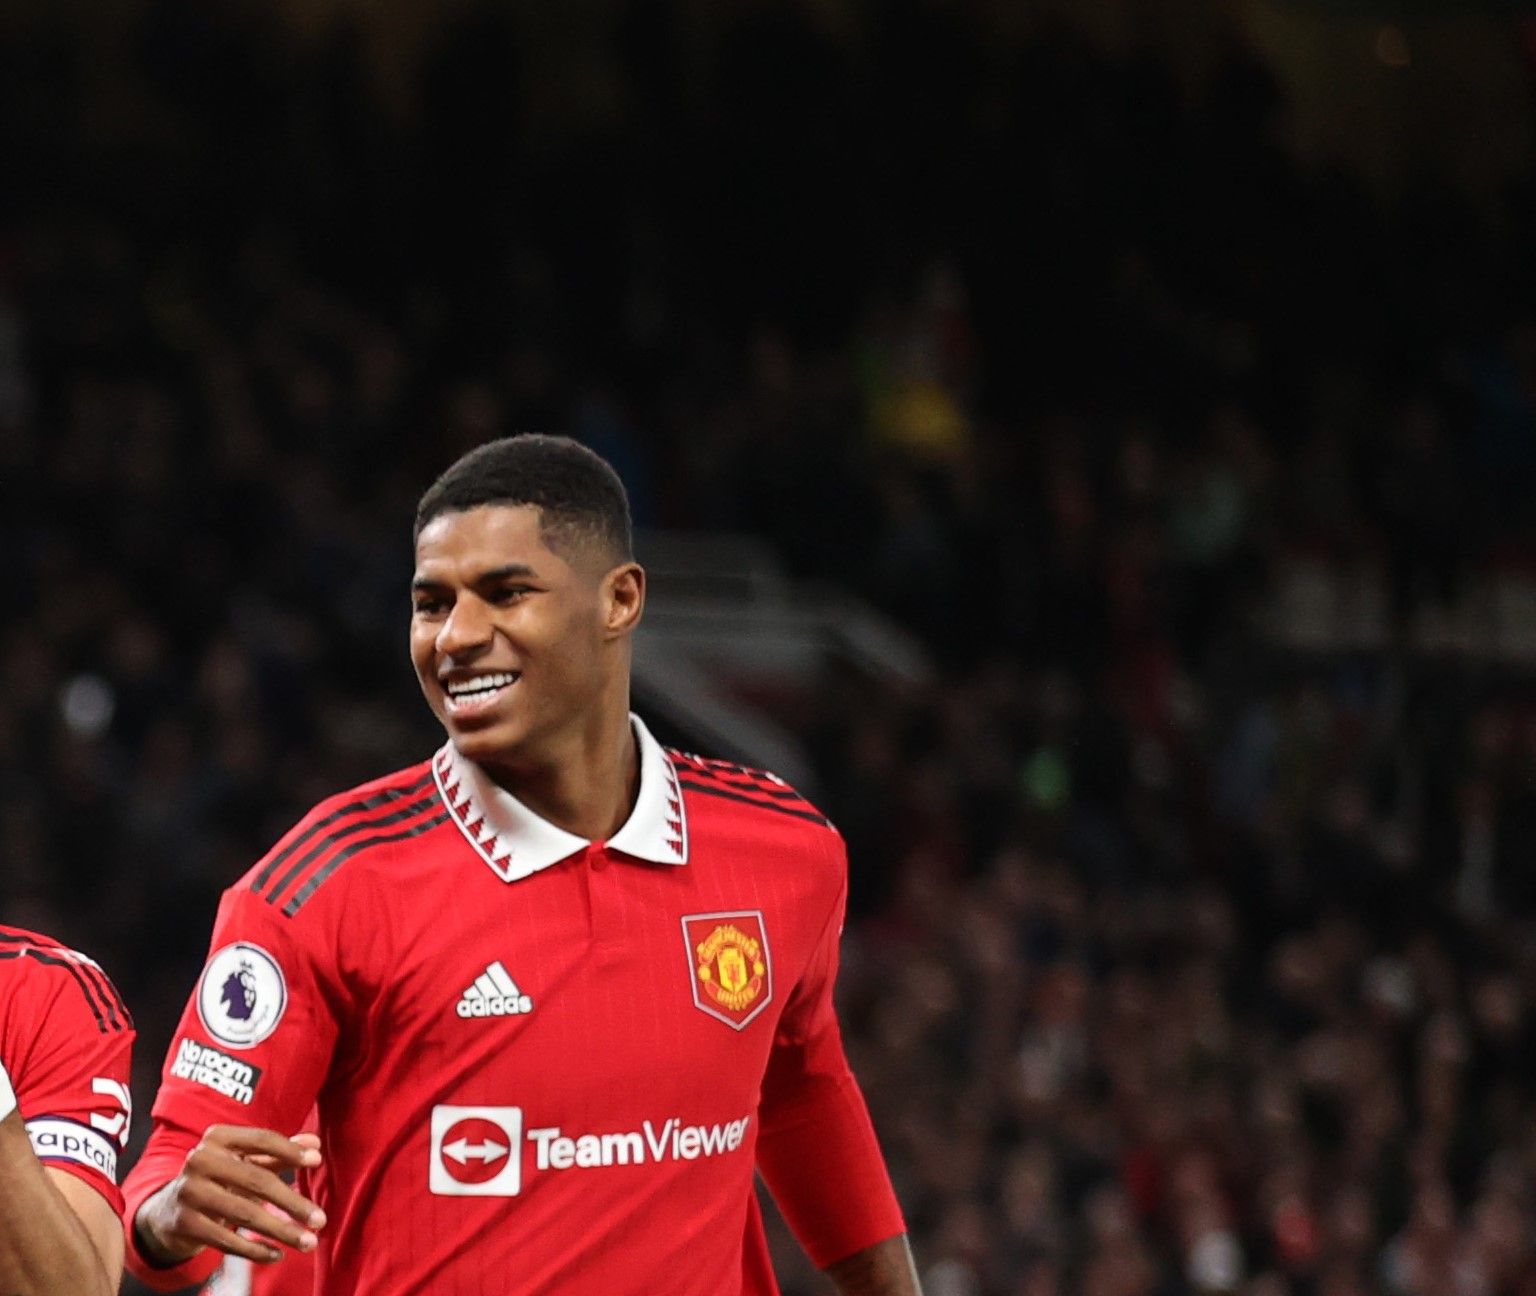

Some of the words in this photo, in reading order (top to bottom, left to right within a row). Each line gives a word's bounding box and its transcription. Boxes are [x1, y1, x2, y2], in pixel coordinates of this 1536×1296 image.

[456, 992, 532, 1017] adidas
[180, 1038, 201, 1063] No
[198, 1048, 253, 1084] room
[191, 1068, 253, 1105] racism
[27, 1130, 116, 1177] aptai
[527, 1117, 749, 1171] TeamViewer
